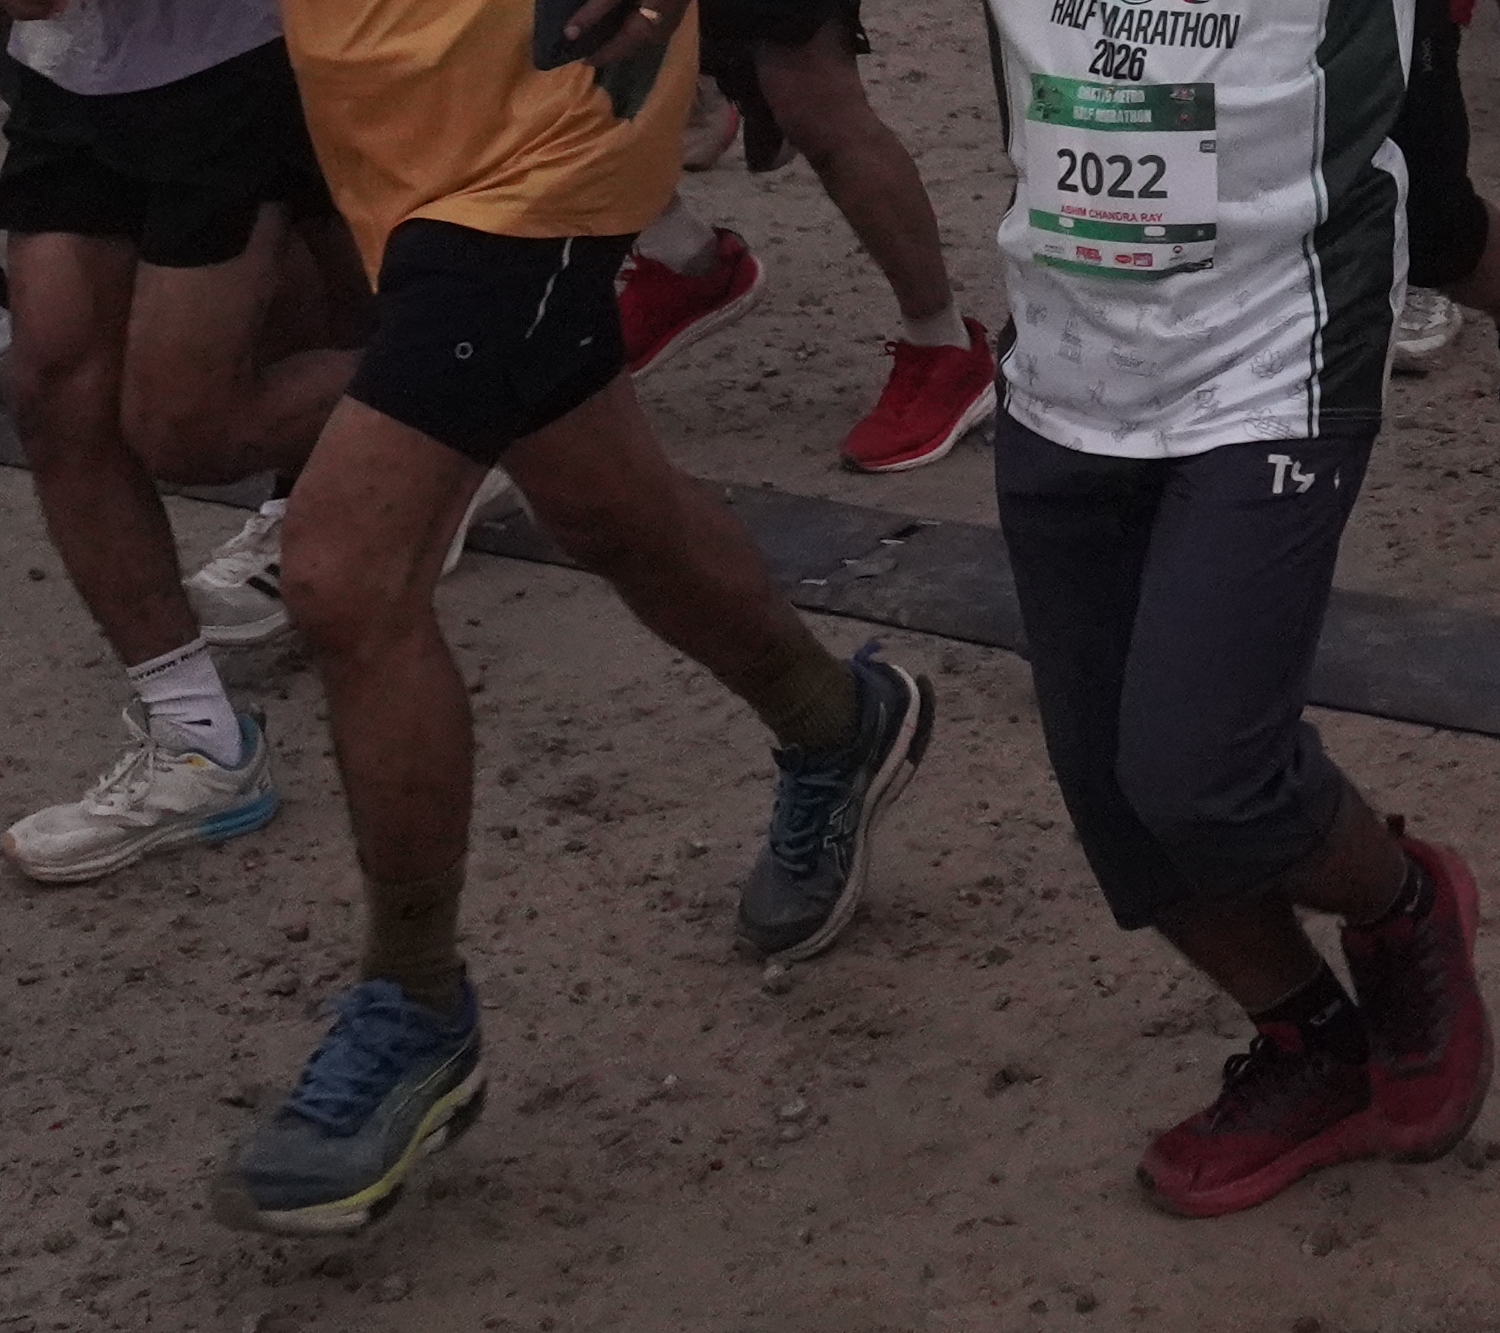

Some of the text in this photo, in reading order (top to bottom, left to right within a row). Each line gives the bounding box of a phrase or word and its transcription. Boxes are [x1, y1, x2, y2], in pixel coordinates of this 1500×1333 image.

[1101, 1, 1241, 49] MARATHON
[1089, 39, 1147, 81] 2026
[1057, 148, 1168, 199] 2022
[1089, 209, 1137, 222] CHANDRA
[1141, 213, 1163, 222] RAY
